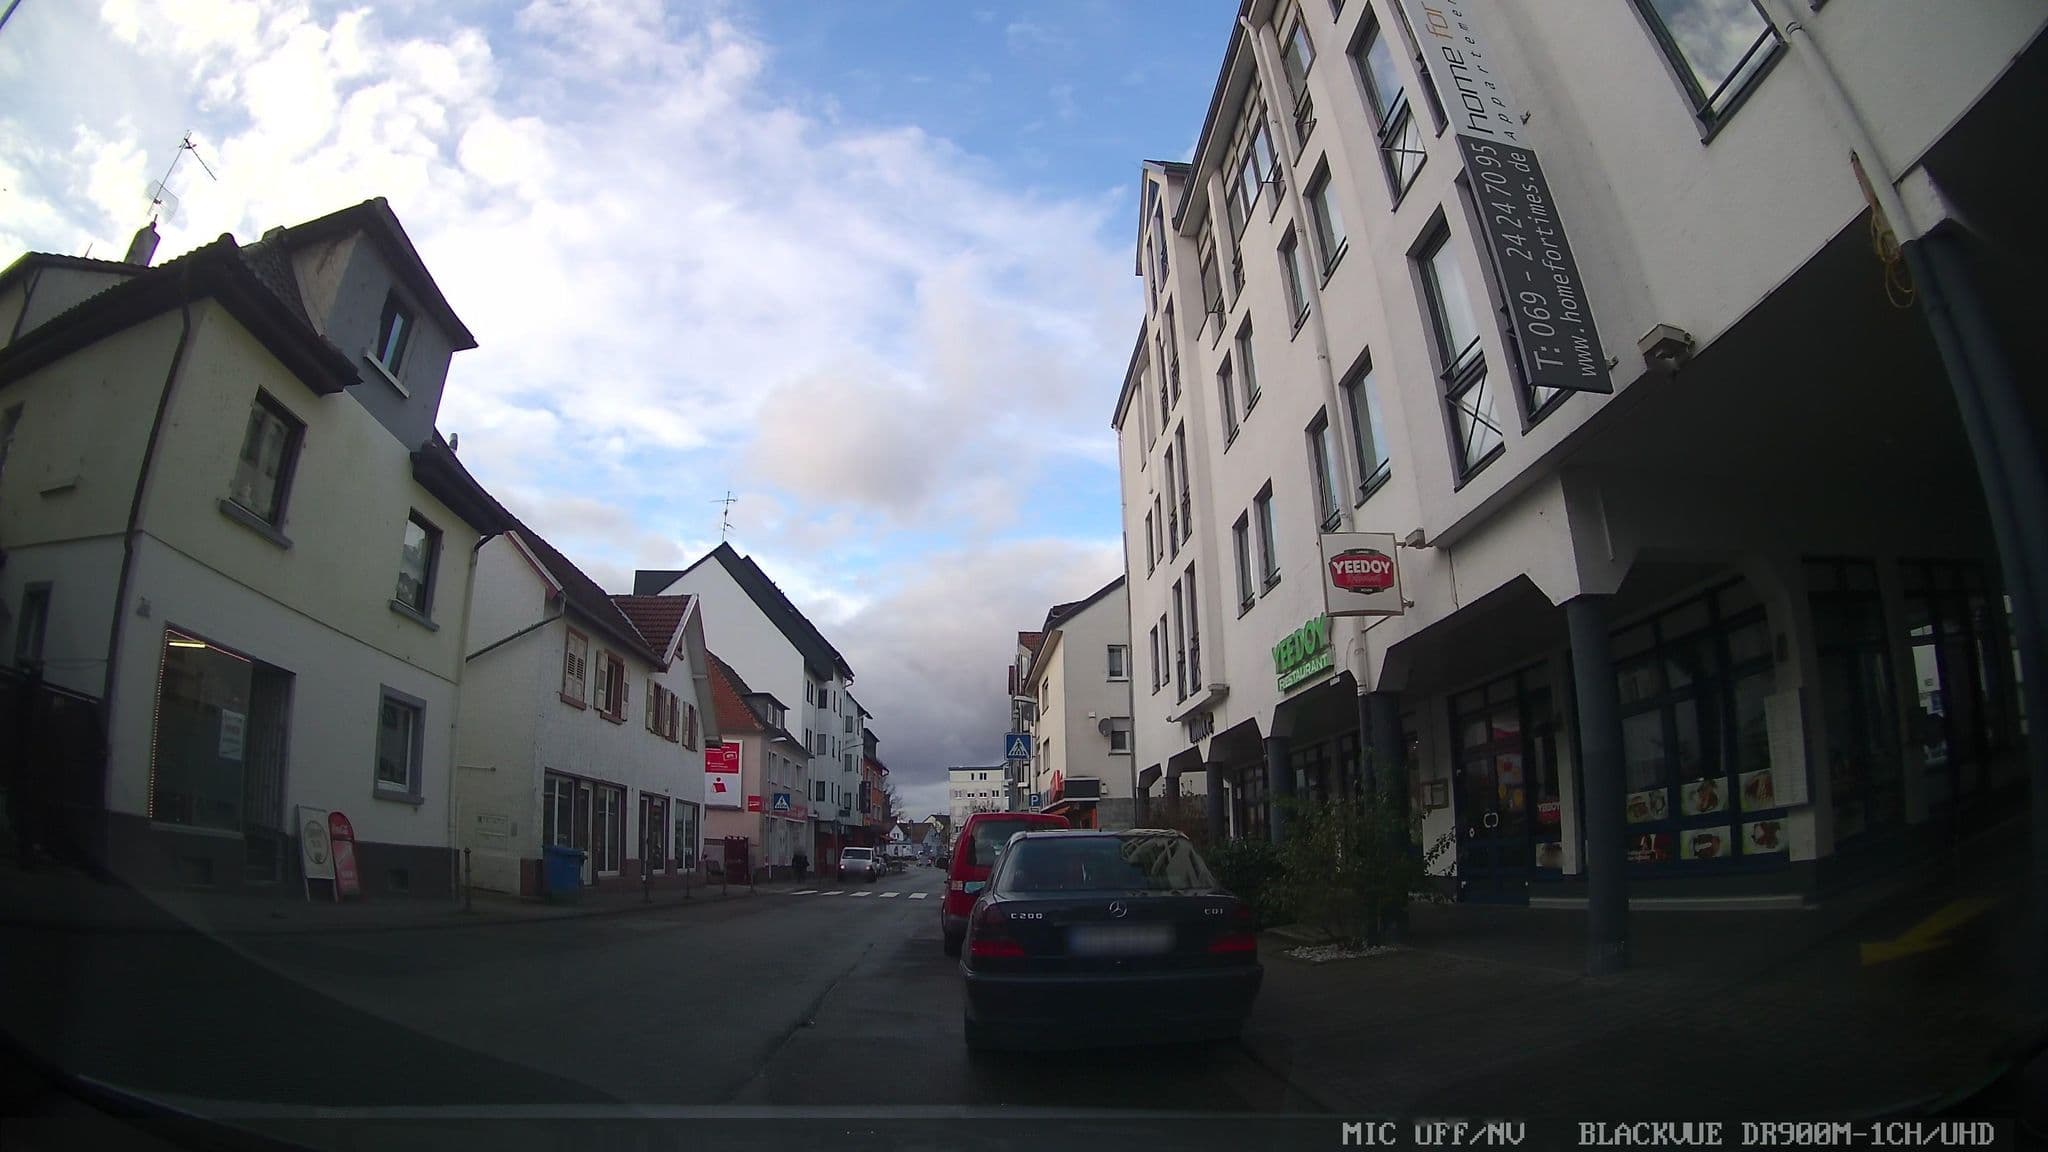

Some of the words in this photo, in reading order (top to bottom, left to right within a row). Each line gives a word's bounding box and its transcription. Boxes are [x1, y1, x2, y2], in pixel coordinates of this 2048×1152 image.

[1442, 46, 1494, 135] home
[1507, 151, 1597, 377] www.homefortimes.de
[1520, 292, 1555, 337] 069
[1533, 347, 1563, 371] T:
[1332, 559, 1391, 575] YEEDOY
[1272, 612, 1326, 673] YEEDOY
[1279, 653, 1330, 690] RESTAURANT
[1031, 795, 1039, 805] P
